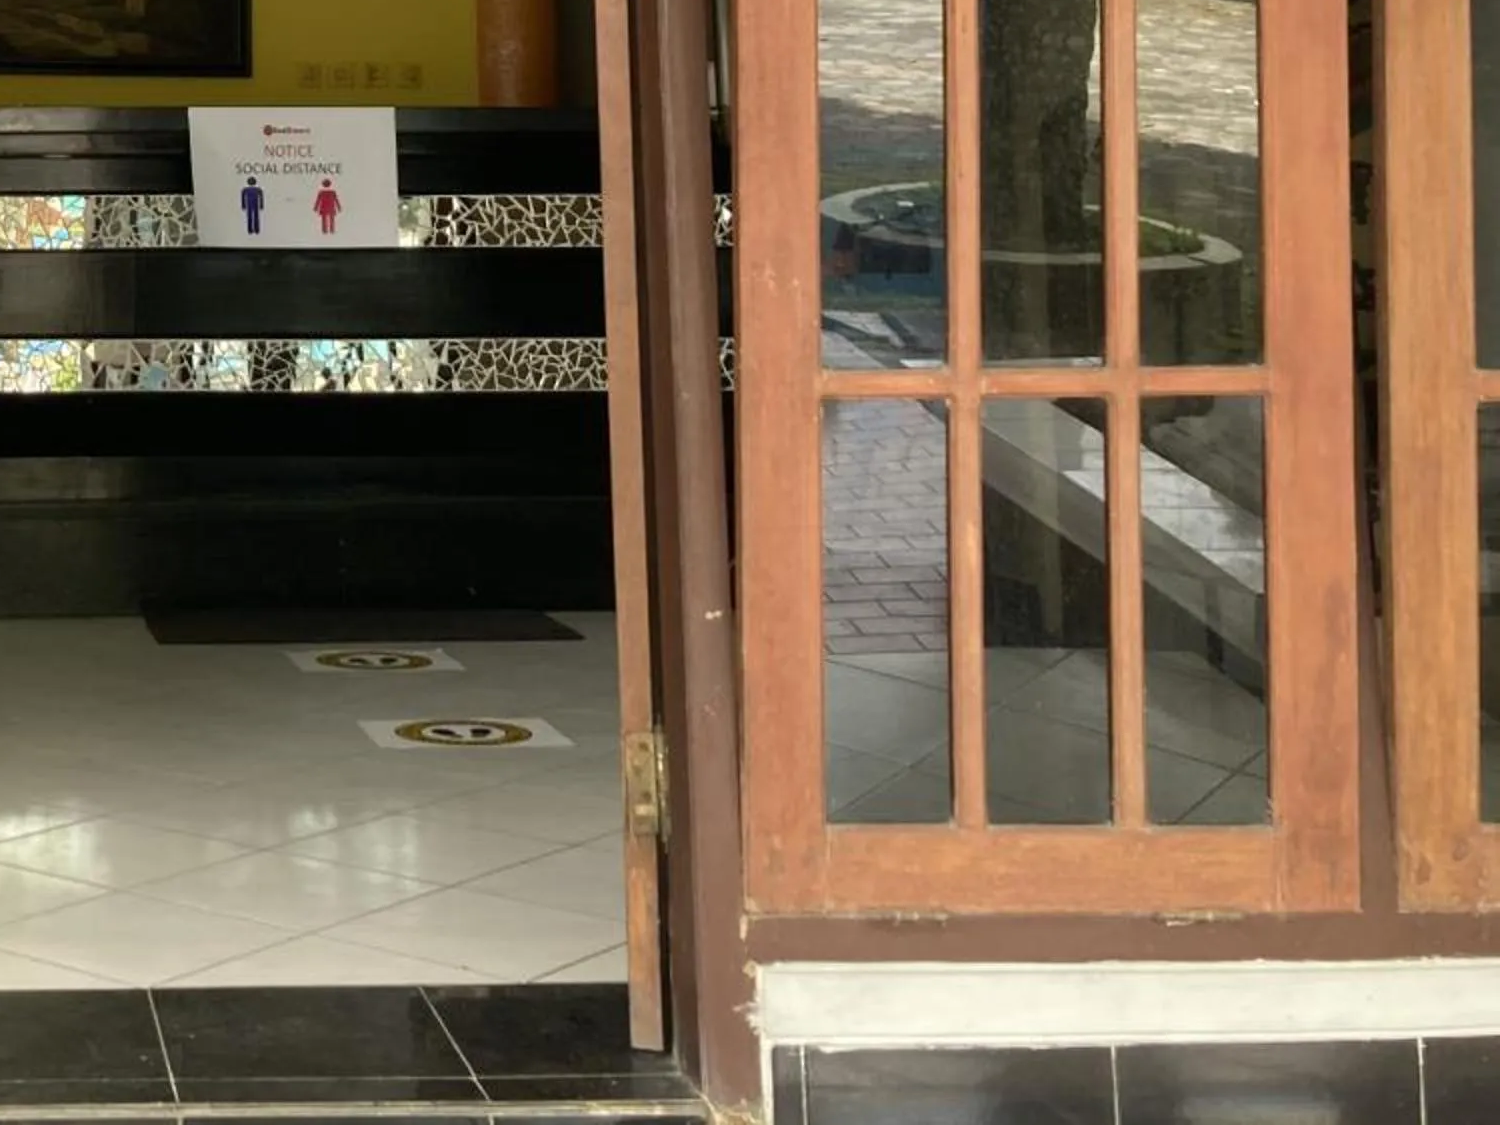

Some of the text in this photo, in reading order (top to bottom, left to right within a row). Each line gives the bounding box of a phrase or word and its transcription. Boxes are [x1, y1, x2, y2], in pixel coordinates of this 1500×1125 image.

[263, 144, 314, 157] NOTICE
[235, 162, 342, 174] SOCIAL DISTANCE
